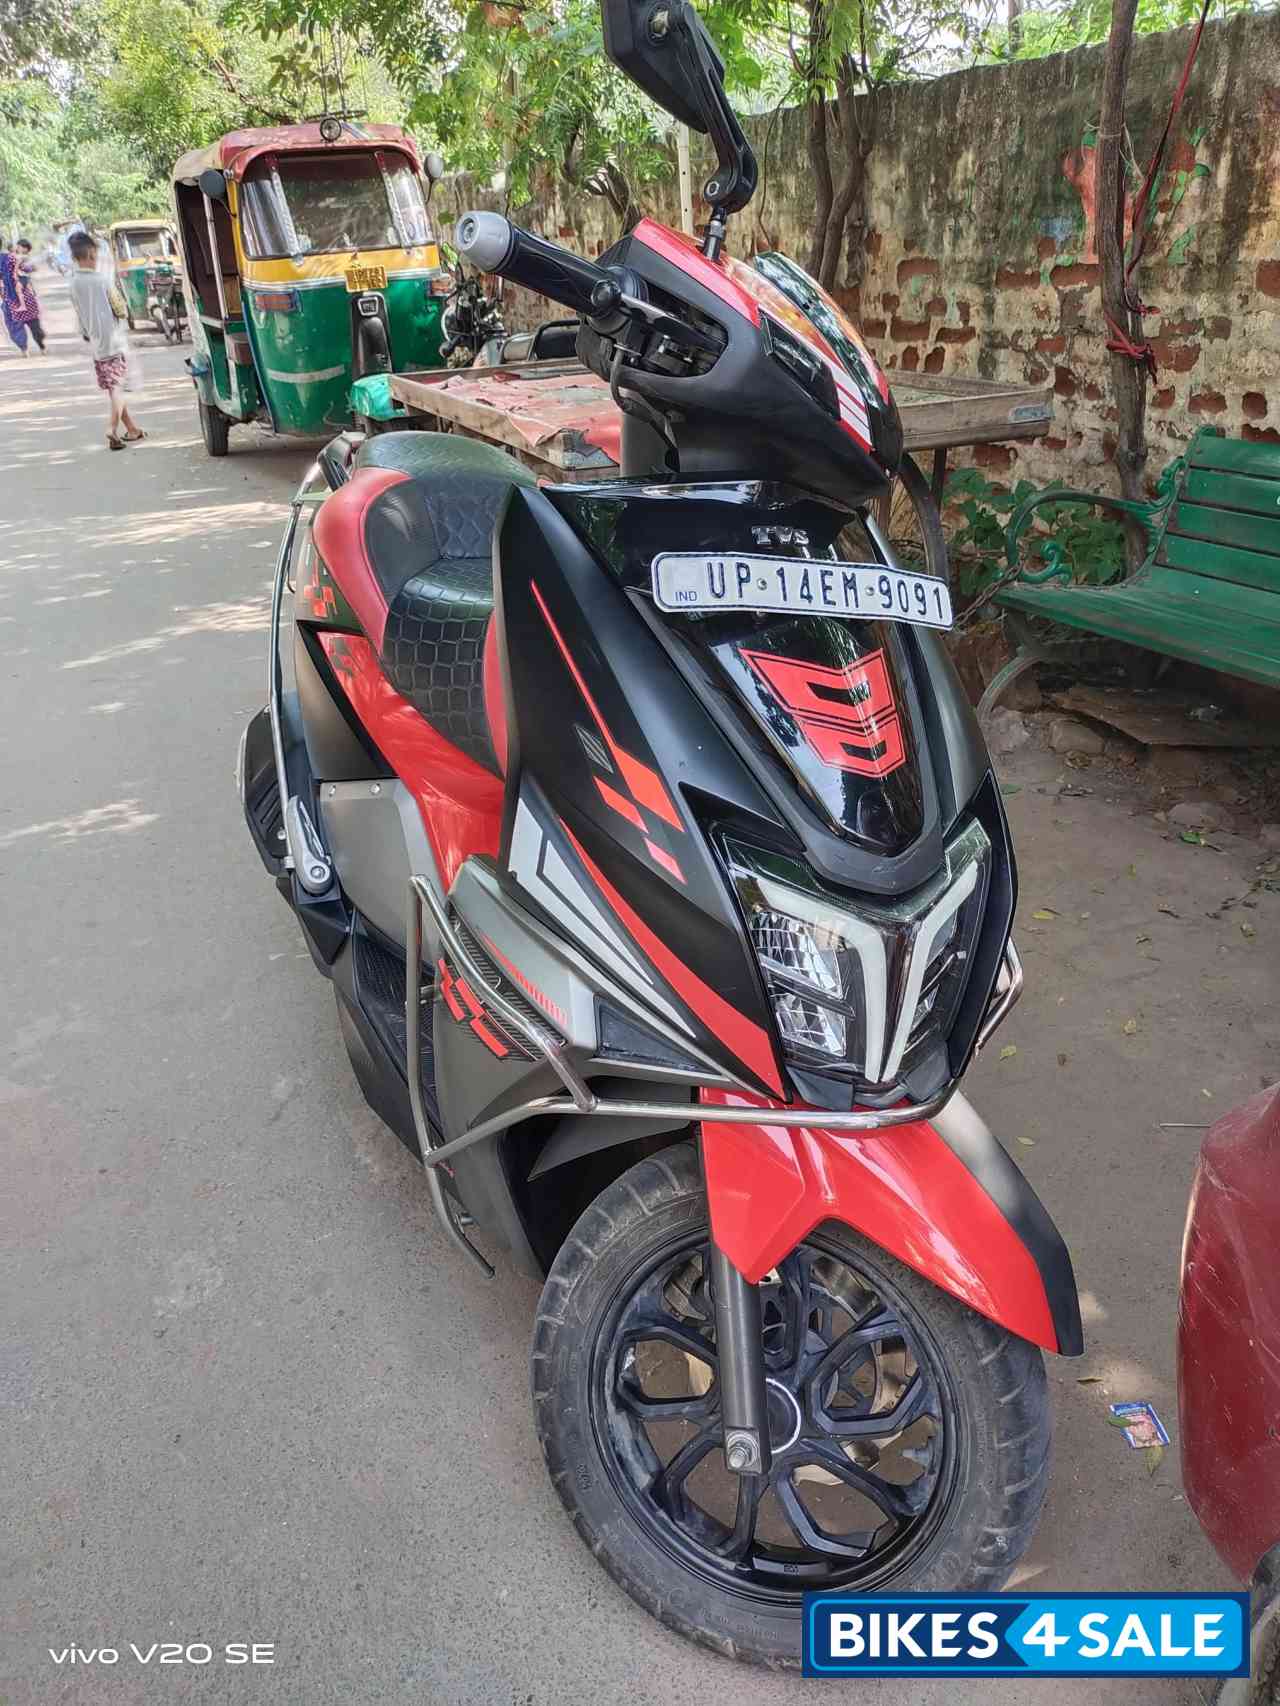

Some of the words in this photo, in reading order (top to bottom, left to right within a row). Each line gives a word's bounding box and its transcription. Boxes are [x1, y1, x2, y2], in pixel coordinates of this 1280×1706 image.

[751, 525, 809, 545] TVS
[674, 591, 698, 602] IND
[706, 561, 752, 599] UP
[775, 566, 860, 609] 14EM
[877, 573, 945, 619] 9091
